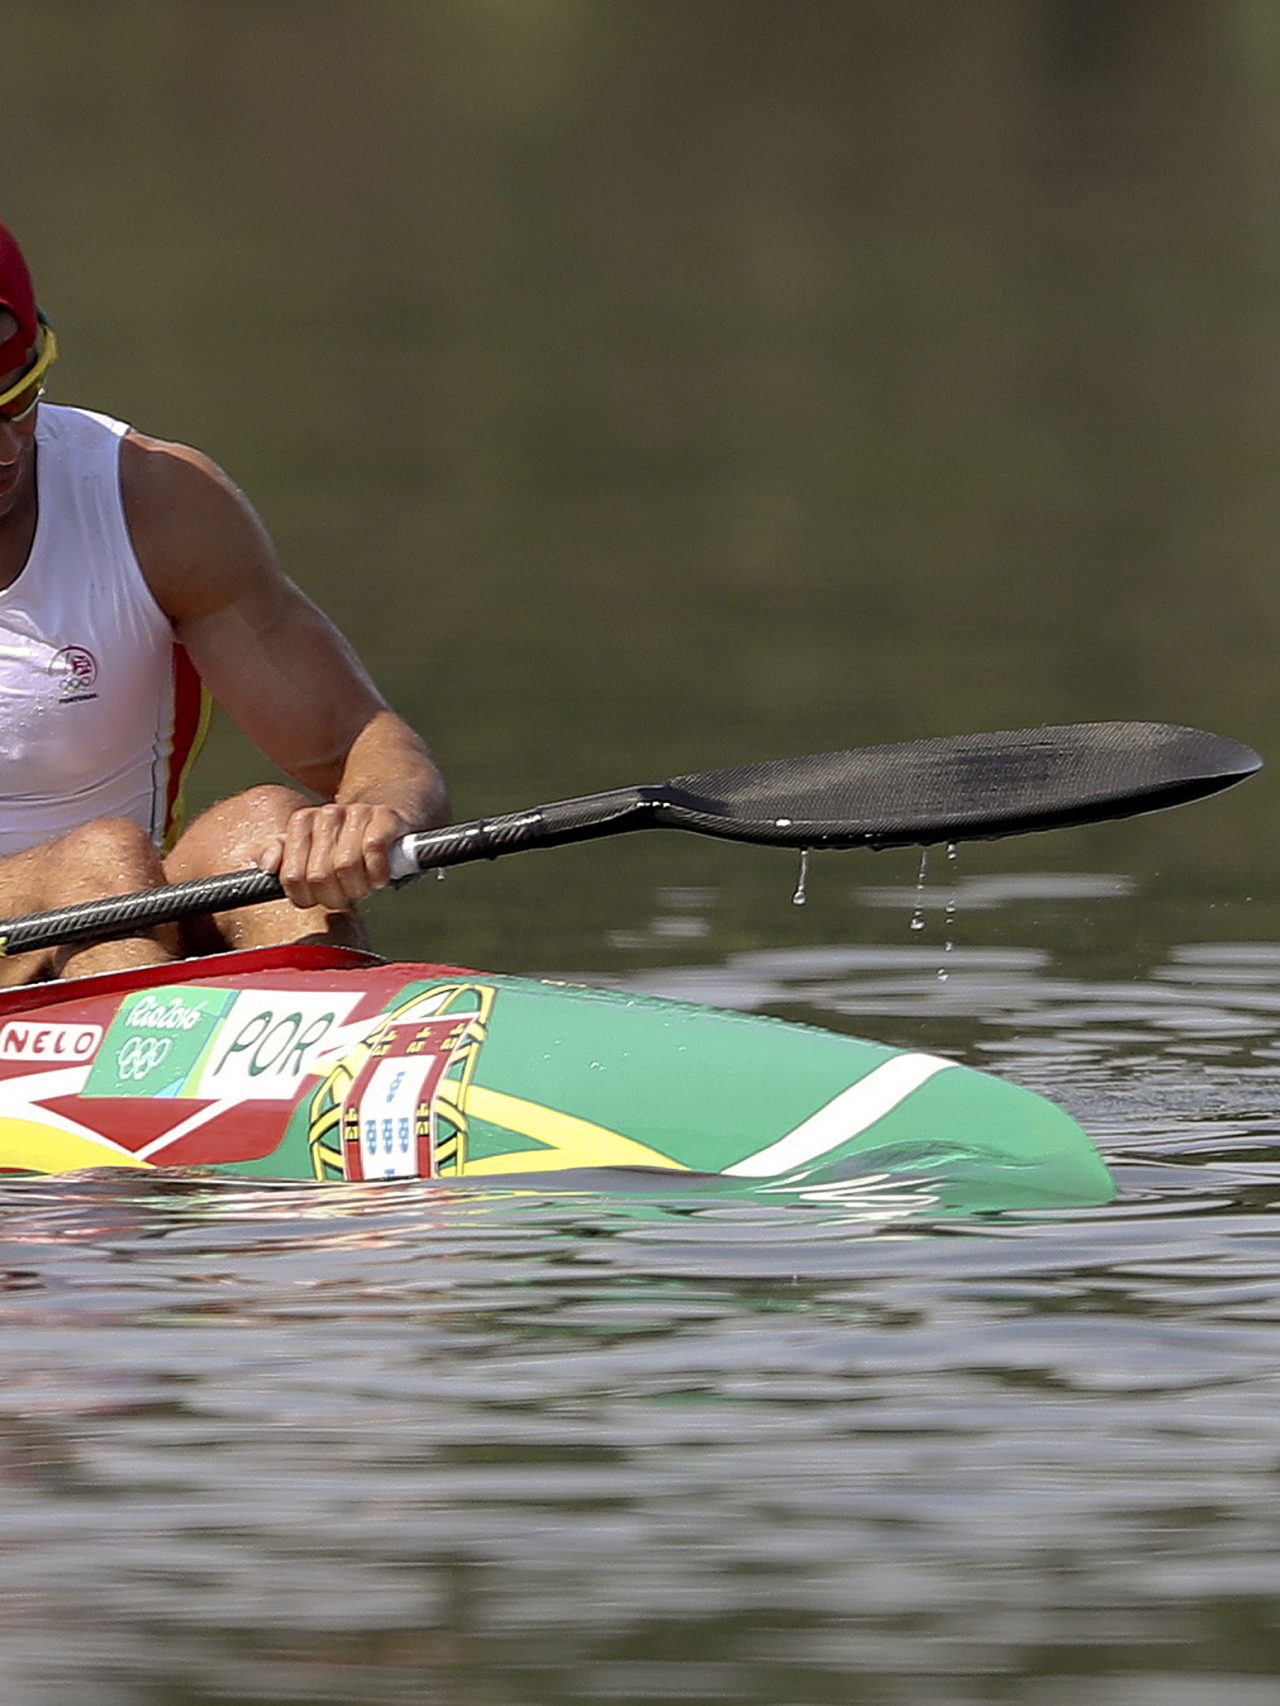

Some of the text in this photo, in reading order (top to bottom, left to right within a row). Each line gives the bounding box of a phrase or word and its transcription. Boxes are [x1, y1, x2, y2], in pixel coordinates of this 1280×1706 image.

[125, 995, 208, 1030] Rio2016
[3, 1028, 95, 1054] NELO
[212, 1010, 336, 1077] POR
